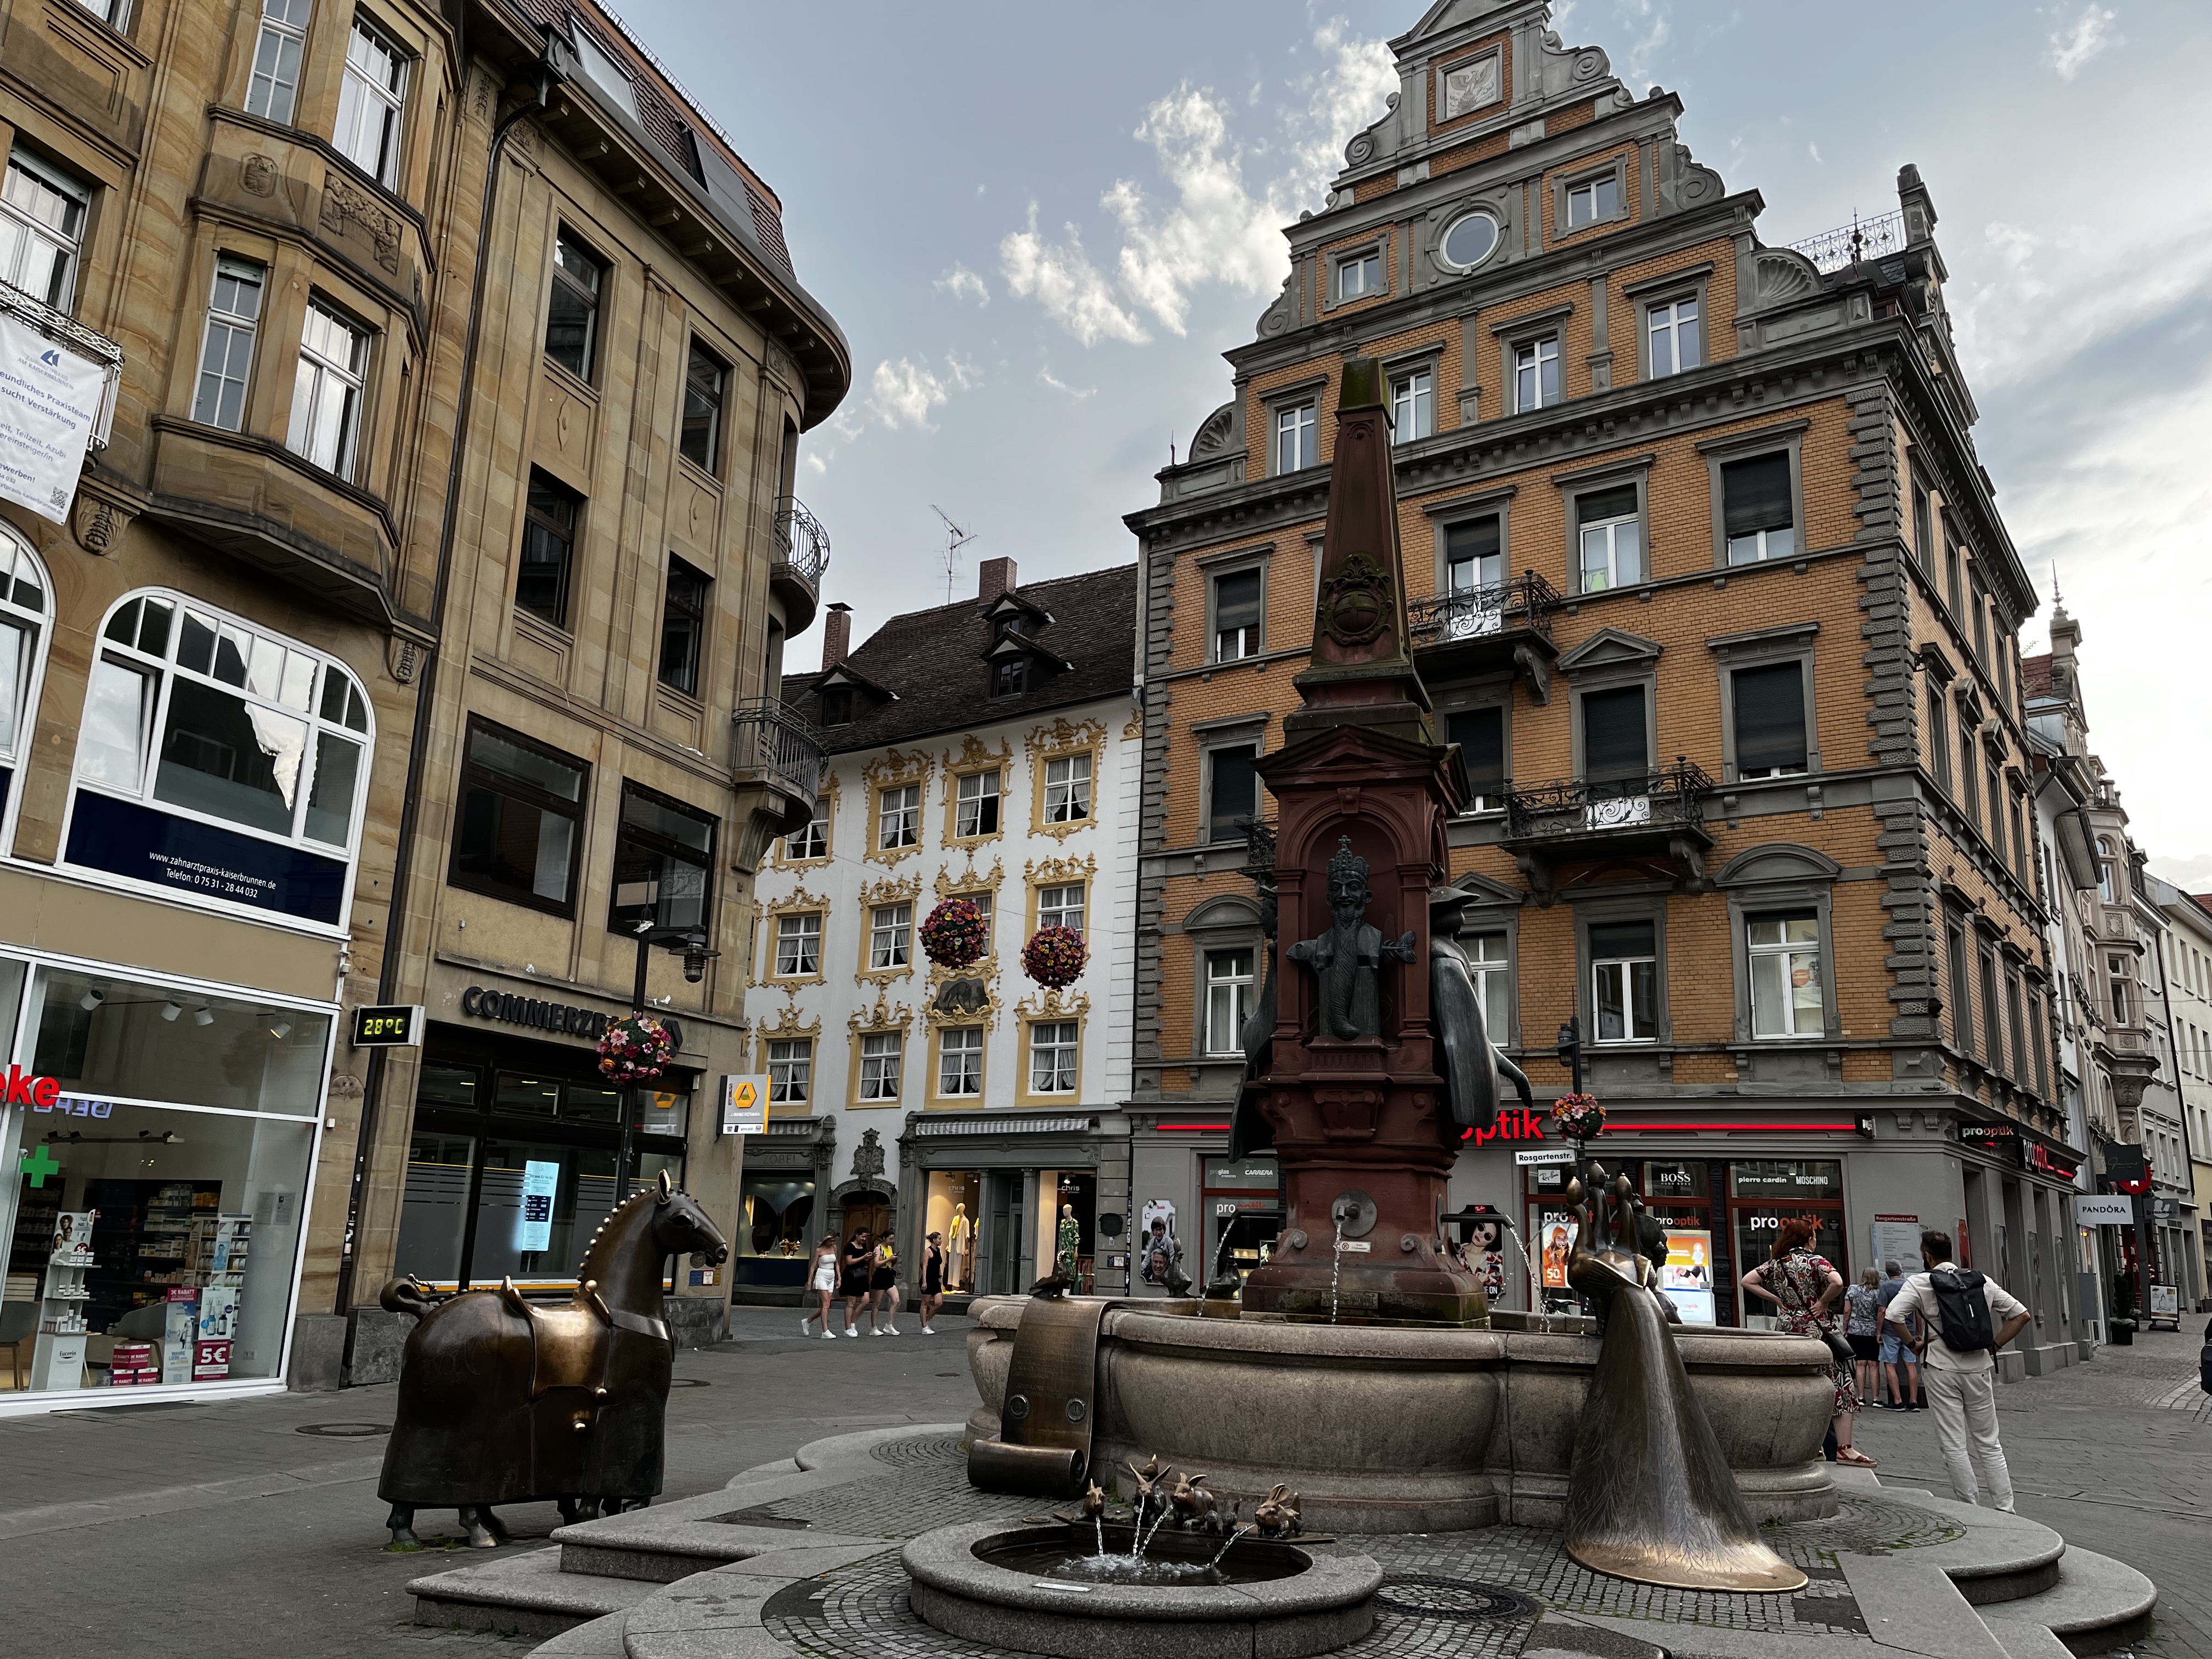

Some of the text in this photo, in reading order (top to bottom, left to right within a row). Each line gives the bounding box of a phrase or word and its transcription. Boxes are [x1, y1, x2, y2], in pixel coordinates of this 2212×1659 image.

[29, 364, 74, 390] KAISERBRUNNEN
[1, 386, 76, 430] sucht Verstärkung
[47, 393, 91, 421] Praxisteam
[0, 422, 66, 458] eit, Teilzeit, Azubi
[149, 851, 276, 890] www.zahnarztpraxis-kaiserbrunnen.de
[166, 868, 193, 883] Telefon:
[195, 876, 200, 884] 0
[201, 877, 210, 886] 75
[211, 879, 219, 889] 31
[225, 882, 234, 892] 28
[235, 885, 244, 895] 44
[245, 888, 258, 898] 032
[464, 986, 620, 1039] COMMERZB
[0, 1064, 60, 1107] ke
[763, 1154, 798, 1164] ZOBEL
[1519, 1153, 1572, 1162] Rosgartenstr.
[1661, 1173, 1691, 1182] BOSS
[1796, 1176, 1829, 1185] MOSCHINO
[1489, 1286, 1498, 1294] ON
[201, 1347, 227, 1363] 5€
